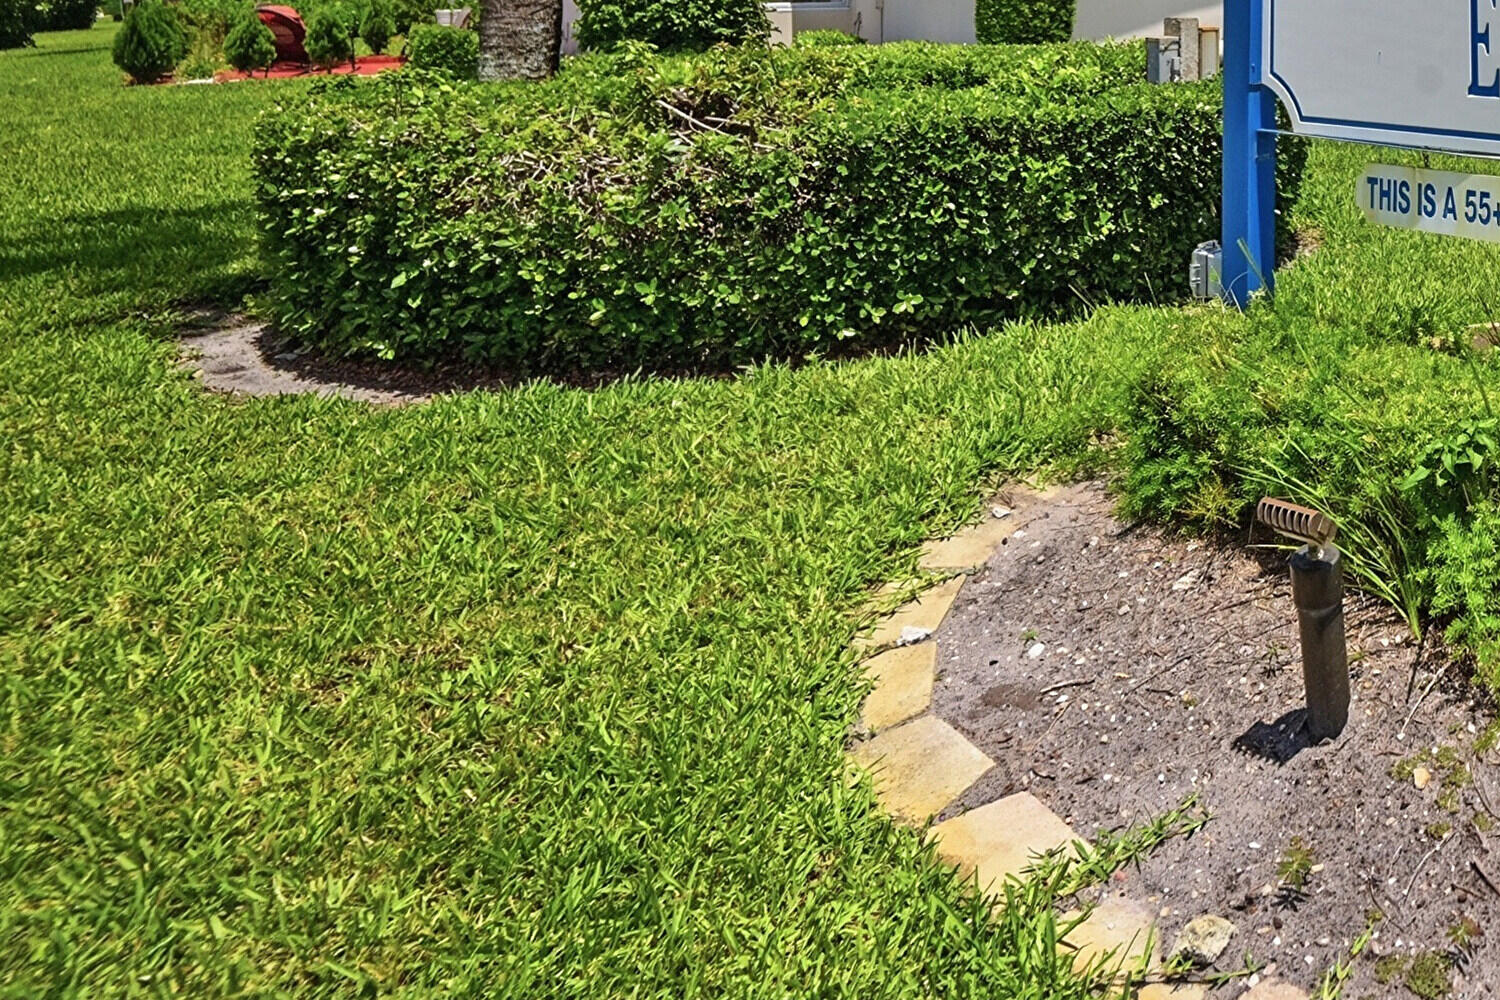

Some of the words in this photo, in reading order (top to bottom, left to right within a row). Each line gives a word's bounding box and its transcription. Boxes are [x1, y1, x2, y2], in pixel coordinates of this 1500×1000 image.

[1367, 176, 1411, 214] THIS
[1417, 182, 1436, 218] IS
[1442, 186, 1458, 221] A
